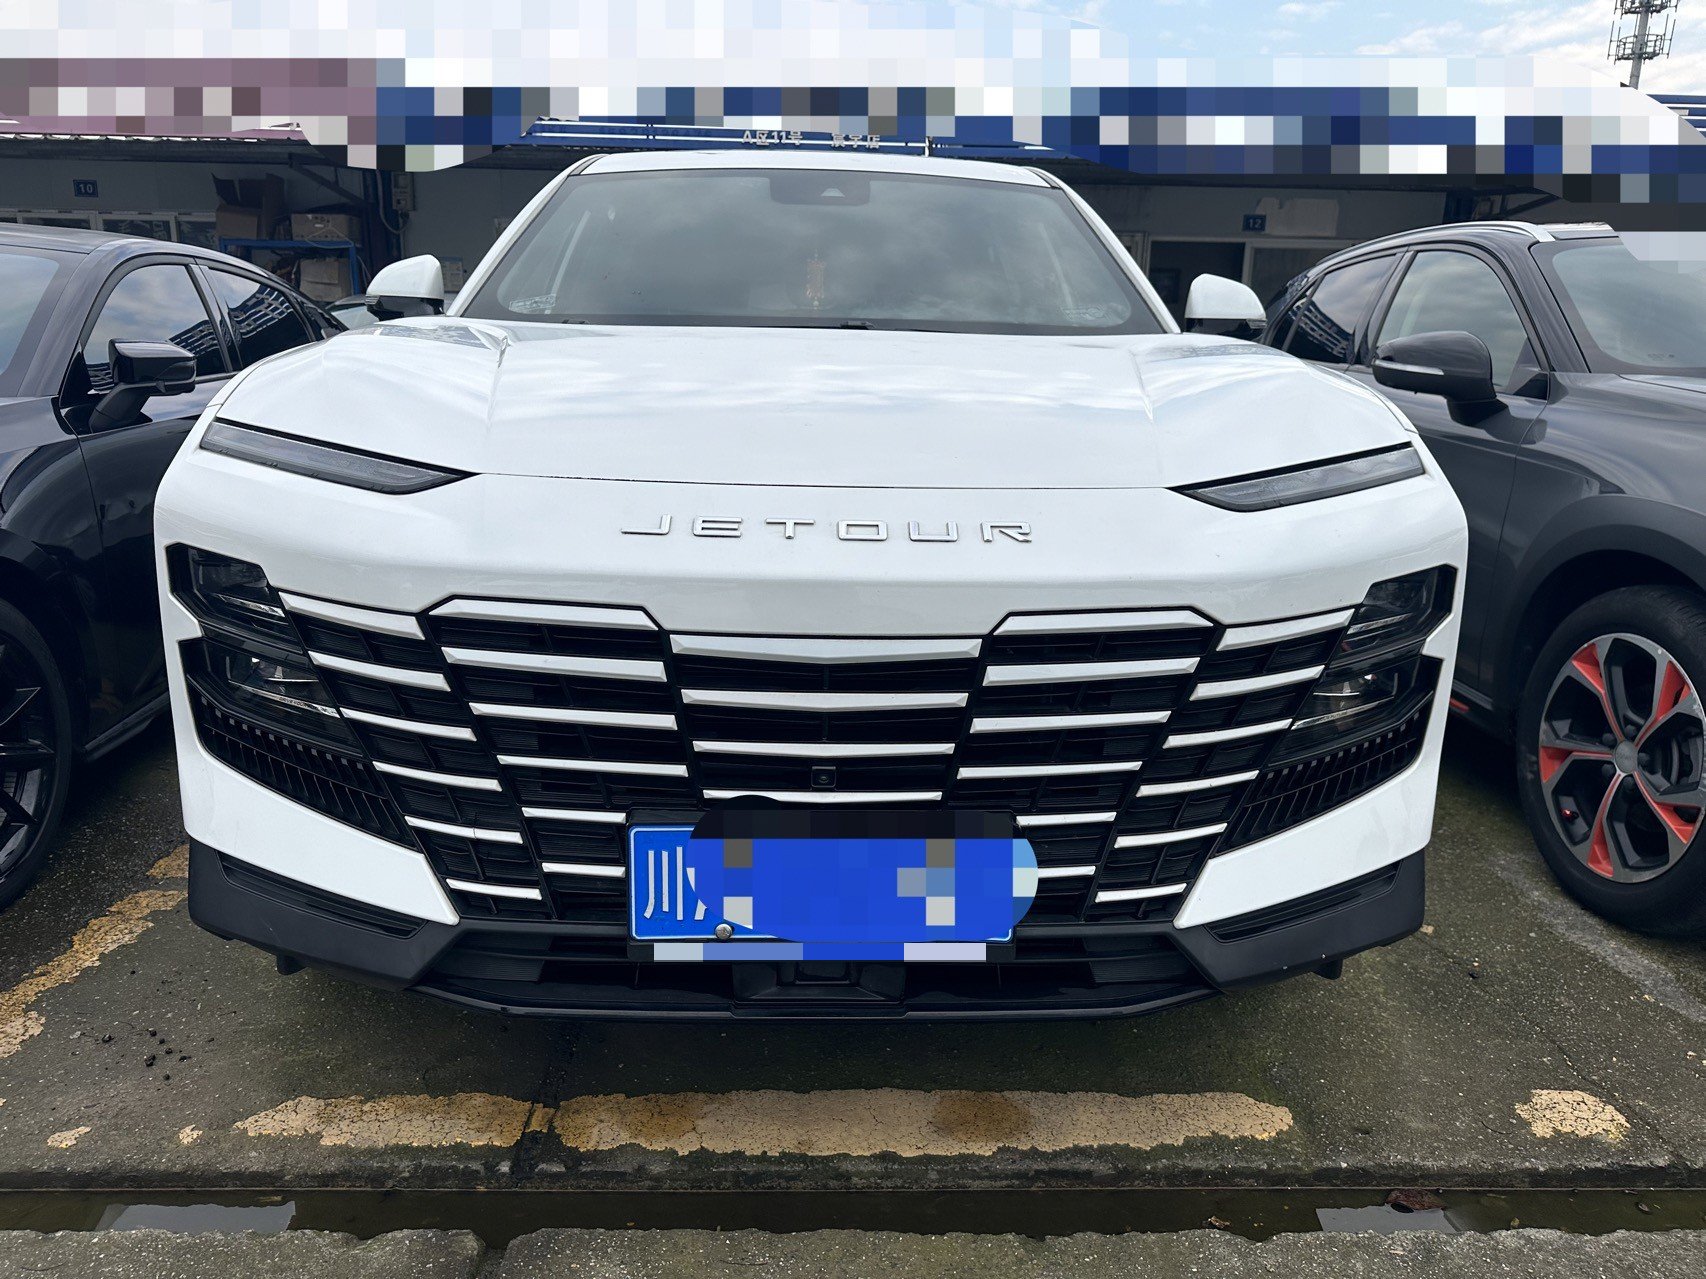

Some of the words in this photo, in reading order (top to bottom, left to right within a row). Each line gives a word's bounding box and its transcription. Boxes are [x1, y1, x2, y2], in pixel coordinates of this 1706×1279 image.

[742, 130, 803, 146] A区11号
[79, 184, 93, 194] 10
[1249, 218, 1262, 229] 12
[620, 514, 1033, 544] JETOUR
[643, 845, 708, 921] 川
